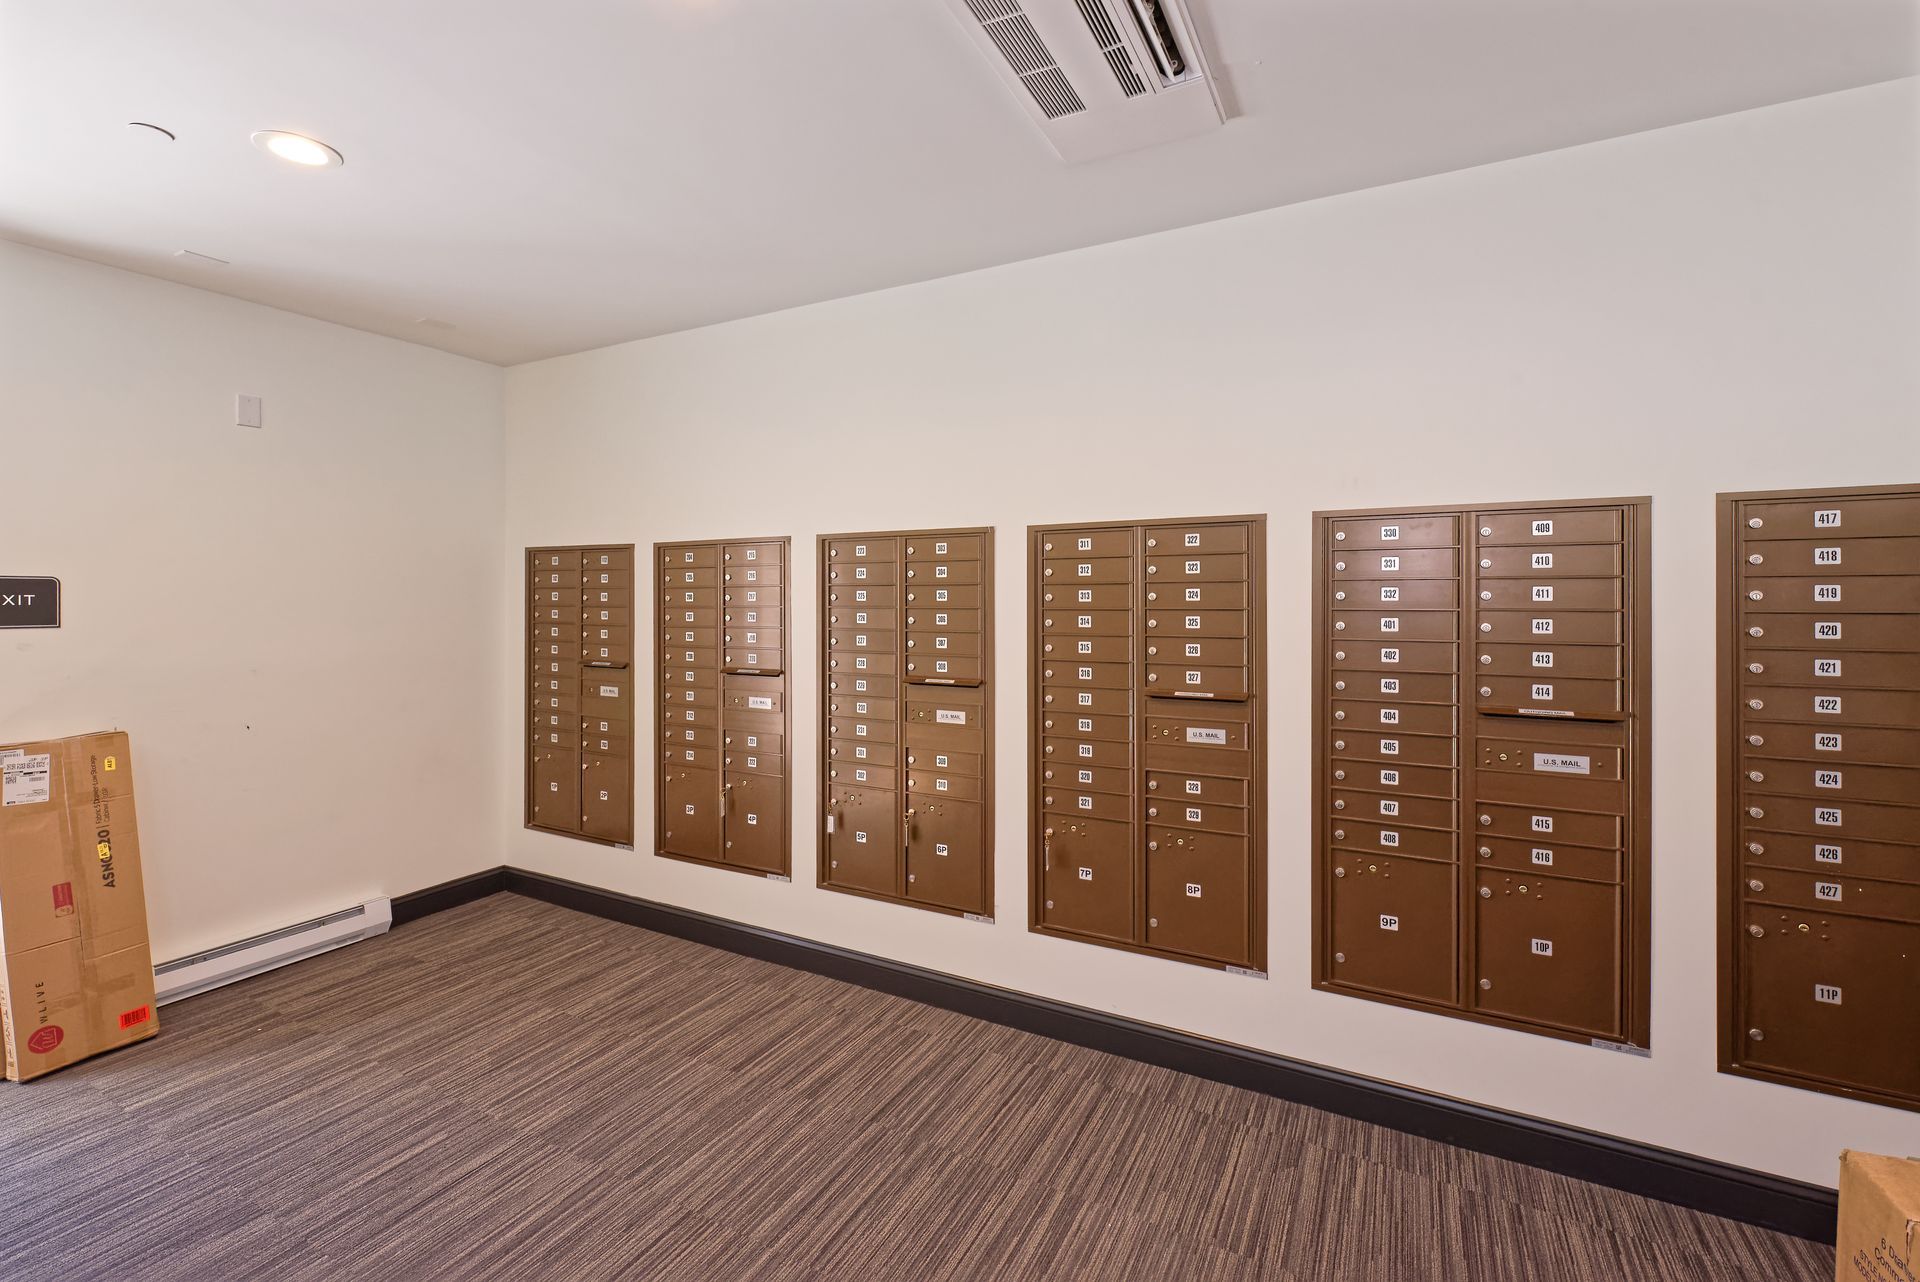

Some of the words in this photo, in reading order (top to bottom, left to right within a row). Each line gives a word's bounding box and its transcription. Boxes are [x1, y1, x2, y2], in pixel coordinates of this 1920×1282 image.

[1818, 513, 1837, 524] 417
[1383, 528, 1397, 538] 330
[1535, 523, 1550, 533] 409
[1080, 540, 1089, 548] 311
[1187, 535, 1198, 544] 322
[1818, 550, 1837, 561] 418
[1383, 559, 1396, 569] 331
[1534, 556, 1550, 566] 410
[937, 568, 946, 576] 304
[1080, 565, 1090, 574] 312
[1187, 563, 1198, 572] 323
[937, 591, 946, 600] 305
[1080, 591, 1090, 600] 313
[1187, 590, 1199, 599] 324
[1383, 589, 1397, 599] 332
[1535, 588, 1549, 599] 411
[1818, 587, 1837, 599] 419
[1080, 617, 1090, 626] 314
[1187, 618, 1199, 627] 325
[1383, 620, 1396, 629] 401
[1535, 621, 1550, 631] 412
[1818, 625, 1837, 636] 420
[937, 639, 946, 647] 307
[1080, 643, 1090, 652] 315
[1383, 650, 1397, 660] 402
[1535, 654, 1550, 665] 413
[1818, 662, 1836, 673] 421
[1188, 673, 1199, 682] 327
[1383, 681, 1397, 691] 403
[1535, 687, 1550, 697] 414
[1080, 695, 1090, 703] 317
[1818, 699, 1837, 711] 422
[1383, 711, 1396, 721] 404
[1383, 742, 1396, 752] 405
[1819, 736, 1838, 748] 423
[1543, 758, 1559, 766] U.S.
[1080, 772, 1090, 781] 320
[1383, 772, 1396, 783] 406
[1819, 773, 1838, 785] 424
[1080, 798, 1090, 807] 321
[1383, 803, 1396, 813] 407
[1819, 811, 1838, 823] 425
[1534, 818, 1550, 830] 415
[1383, 833, 1396, 844] 408
[937, 845, 947, 853] 6P
[1819, 848, 1838, 860] 426
[1535, 851, 1550, 863] 416
[1080, 869, 1091, 878] 7P
[1187, 885, 1200, 894] 8P
[1819, 885, 1838, 897] 427
[1381, 917, 1397, 927] 9P
[1535, 942, 1550, 953] 10P
[1820, 988, 1838, 1000] 11P
[35, 981, 48, 1024] WLIVE
